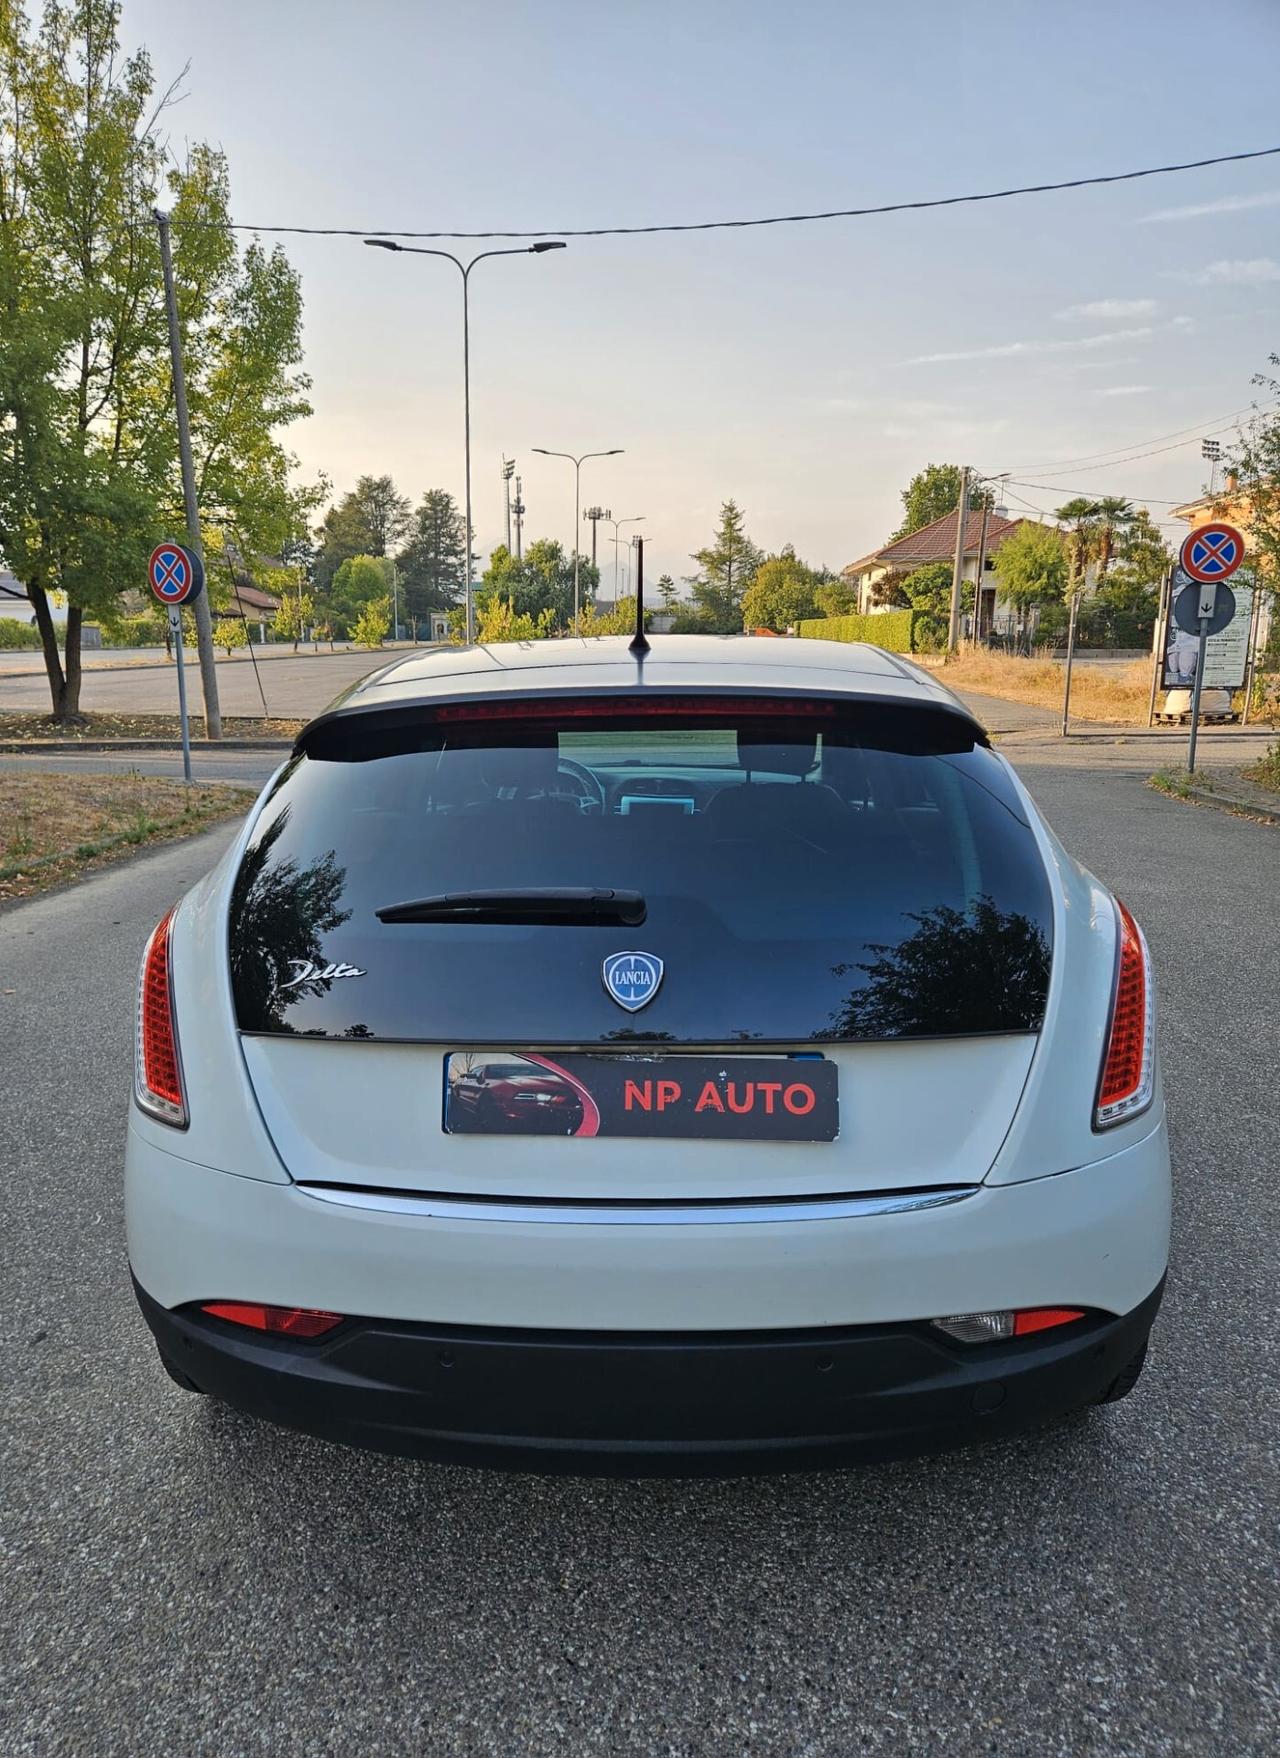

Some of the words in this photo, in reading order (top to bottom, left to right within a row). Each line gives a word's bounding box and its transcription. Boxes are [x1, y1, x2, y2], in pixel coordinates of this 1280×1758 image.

[281, 960, 366, 987] Delta
[615, 971, 651, 985] LANCIA
[624, 1080, 682, 1112] NP
[694, 1080, 816, 1114] AUTO
